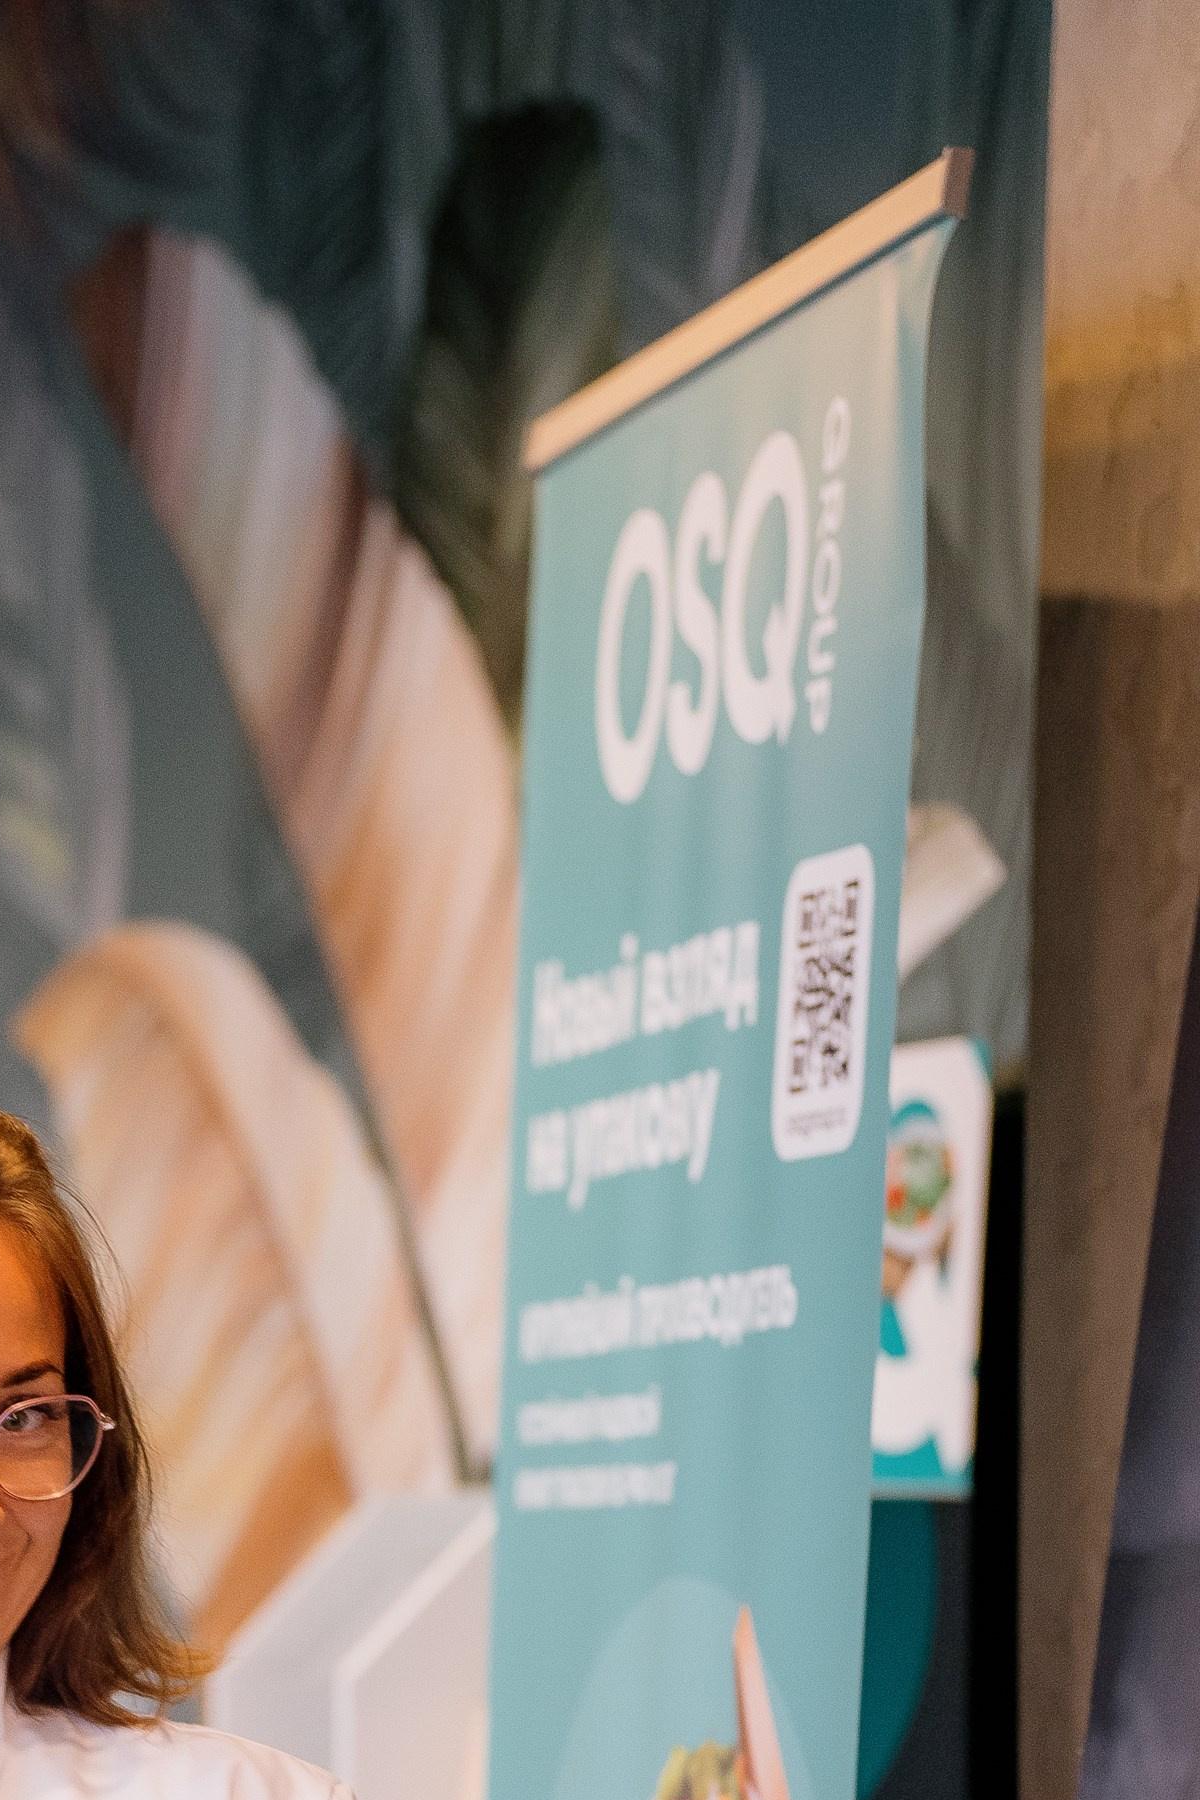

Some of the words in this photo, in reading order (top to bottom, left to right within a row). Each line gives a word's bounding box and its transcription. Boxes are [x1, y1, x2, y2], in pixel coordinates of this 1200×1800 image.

[595, 430, 808, 804] OSQ
[804, 395, 851, 735] GROUP
[641, 919, 761, 1034] взгляд
